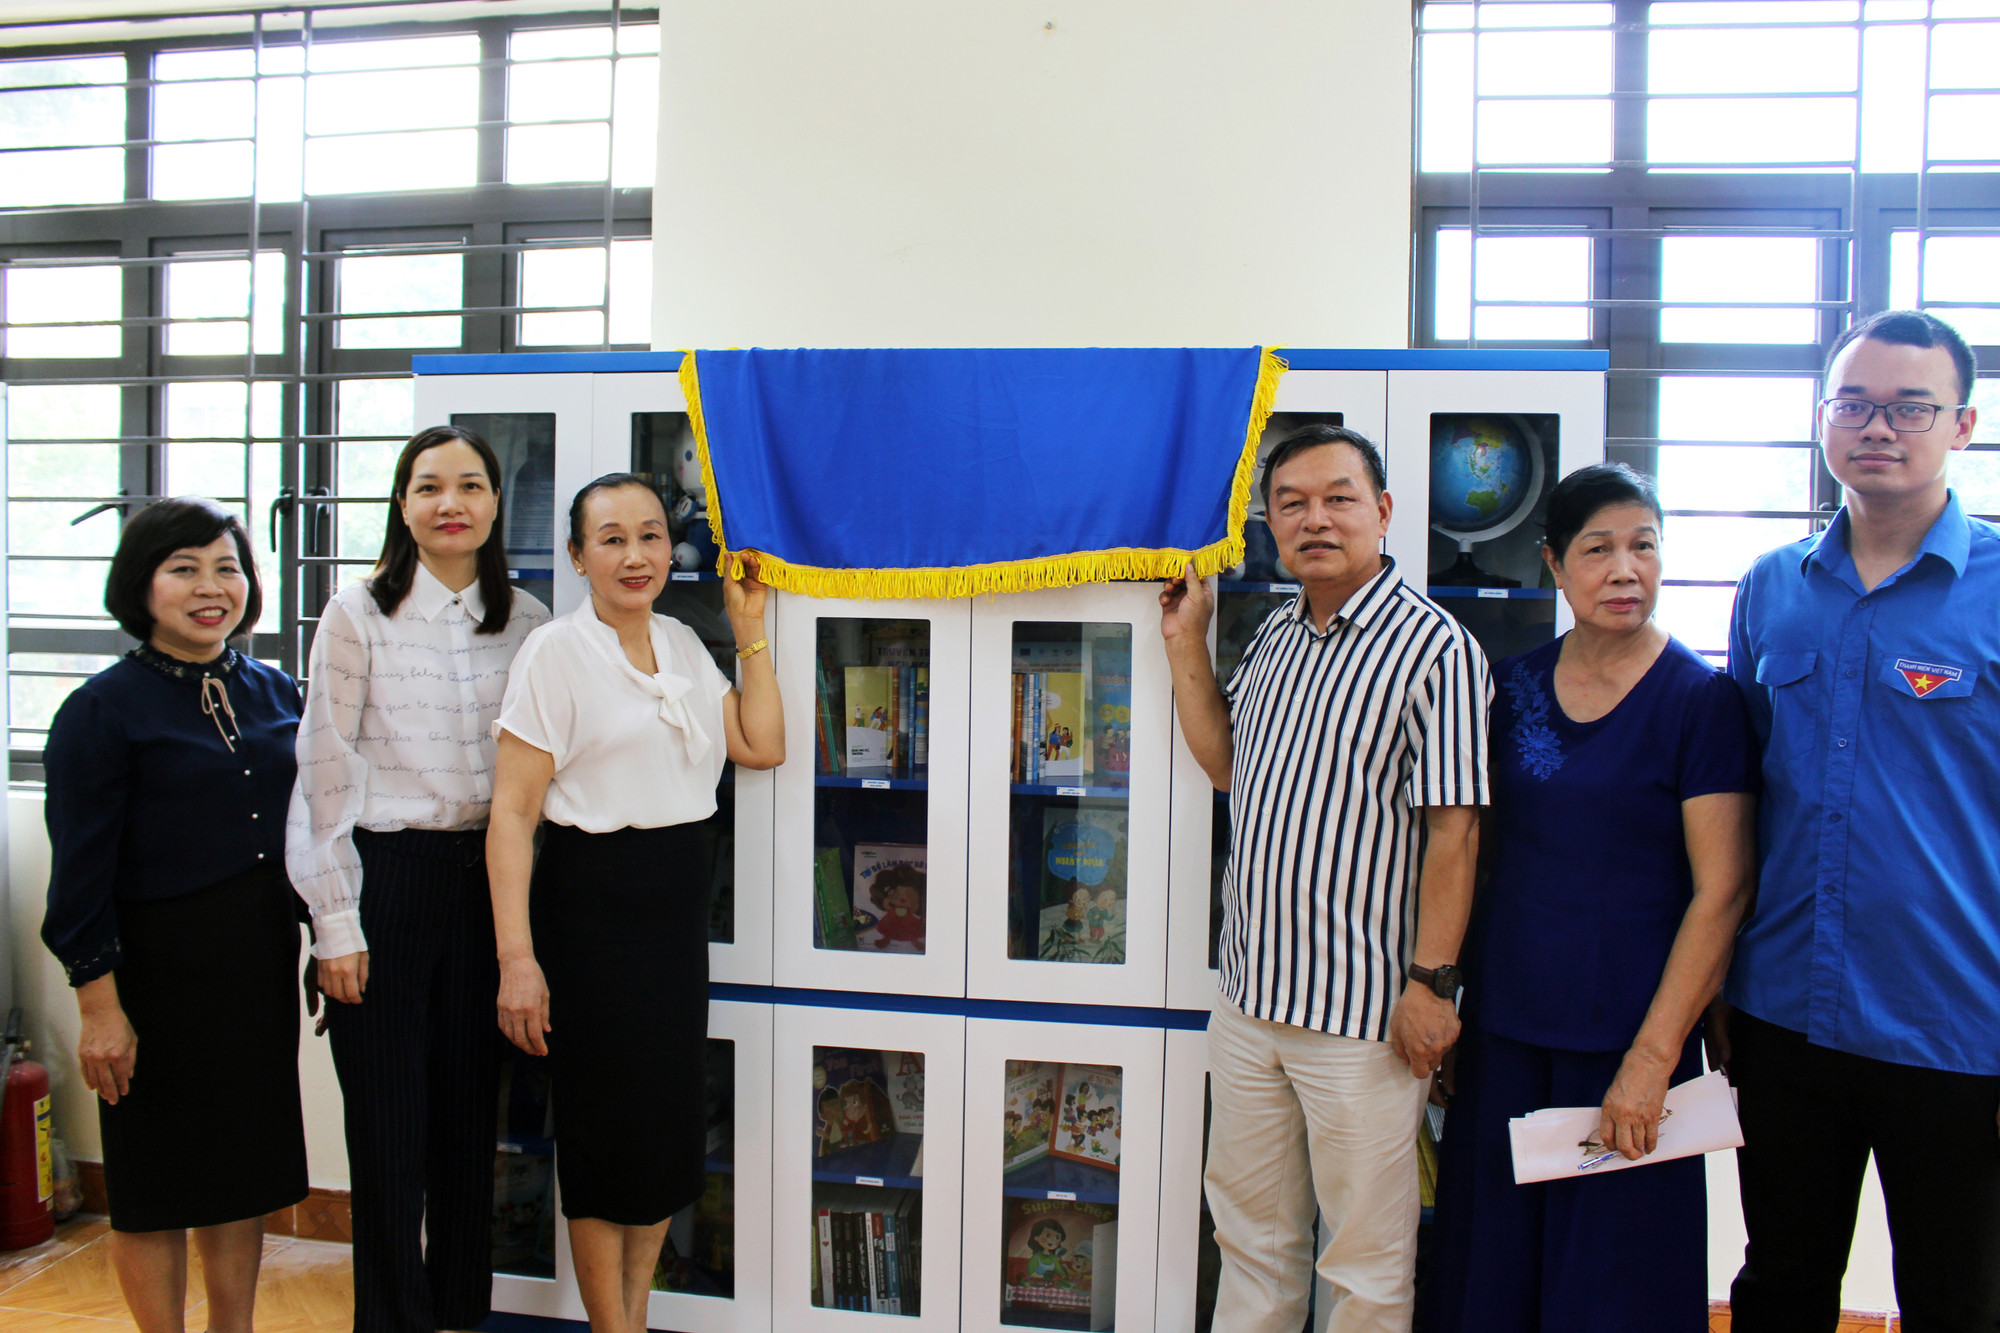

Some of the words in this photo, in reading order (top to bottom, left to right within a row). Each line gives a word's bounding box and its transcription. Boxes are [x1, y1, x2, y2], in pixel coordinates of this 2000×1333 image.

[1943, 669, 1958, 677] NAM
[825, 1057, 848, 1072] You
[1021, 1201, 1069, 1215] Super
[1073, 1201, 1113, 1221] Chef
